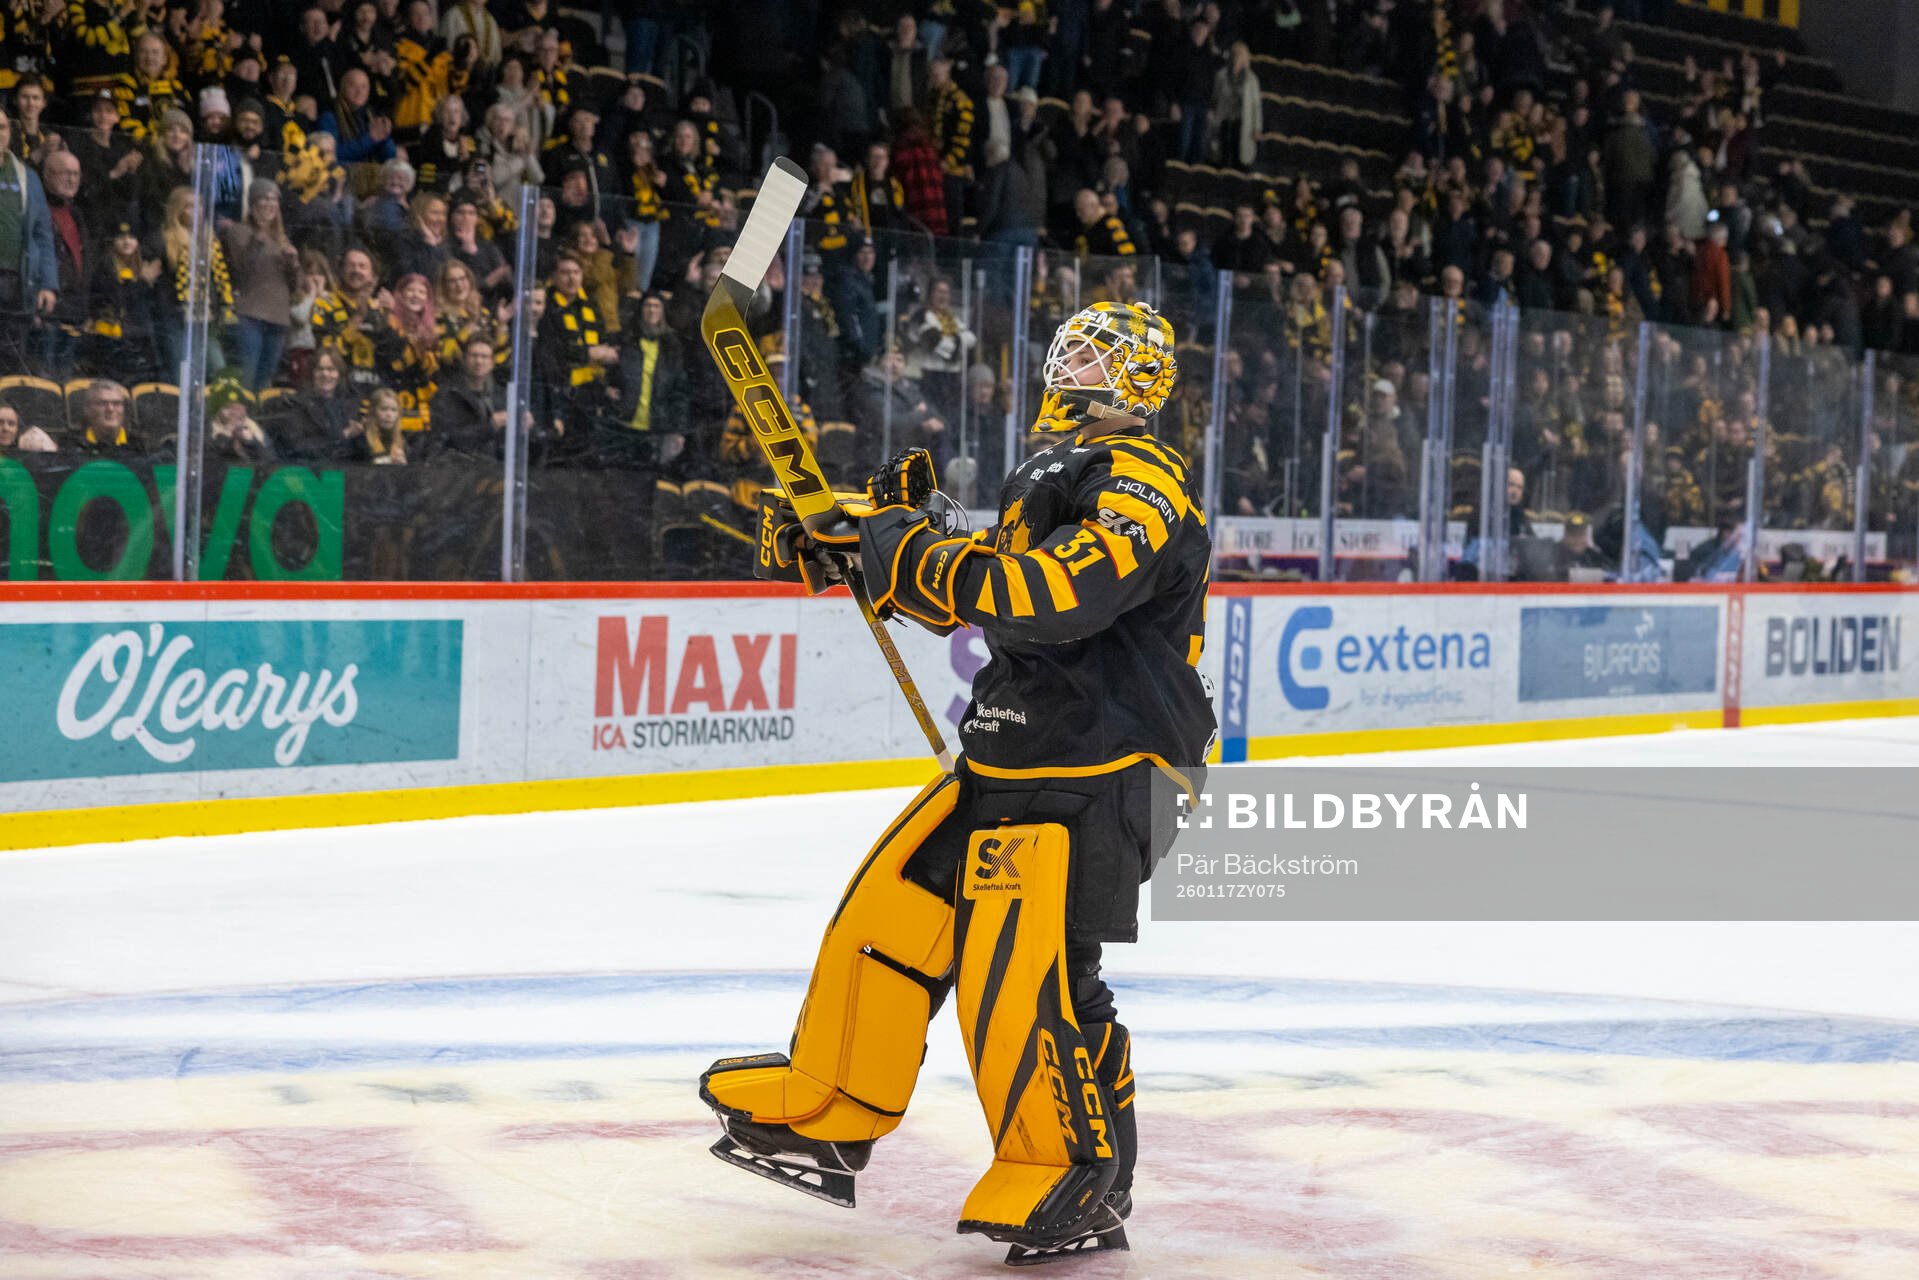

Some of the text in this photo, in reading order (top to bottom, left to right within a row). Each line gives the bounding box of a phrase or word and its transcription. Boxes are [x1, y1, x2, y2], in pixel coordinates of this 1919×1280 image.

[712, 327, 825, 499] CCM
[1115, 480, 1175, 523] HOLMEN
[760, 504, 775, 568] CCM
[1054, 528, 1106, 577] 31
[932, 550, 949, 590] CCM
[594, 615, 797, 718] MAXI
[872, 620, 913, 683] CCM
[1228, 603, 1246, 727] CCM
[1336, 625, 1491, 674] extena
[1765, 615, 1901, 677] BOLIDEN
[57, 622, 359, 766] O'Learys
[592, 716, 795, 751] ICA STORMARKNAD
[1040, 1028, 1078, 1144] CCM
[1073, 1047, 1113, 1158] CCM
